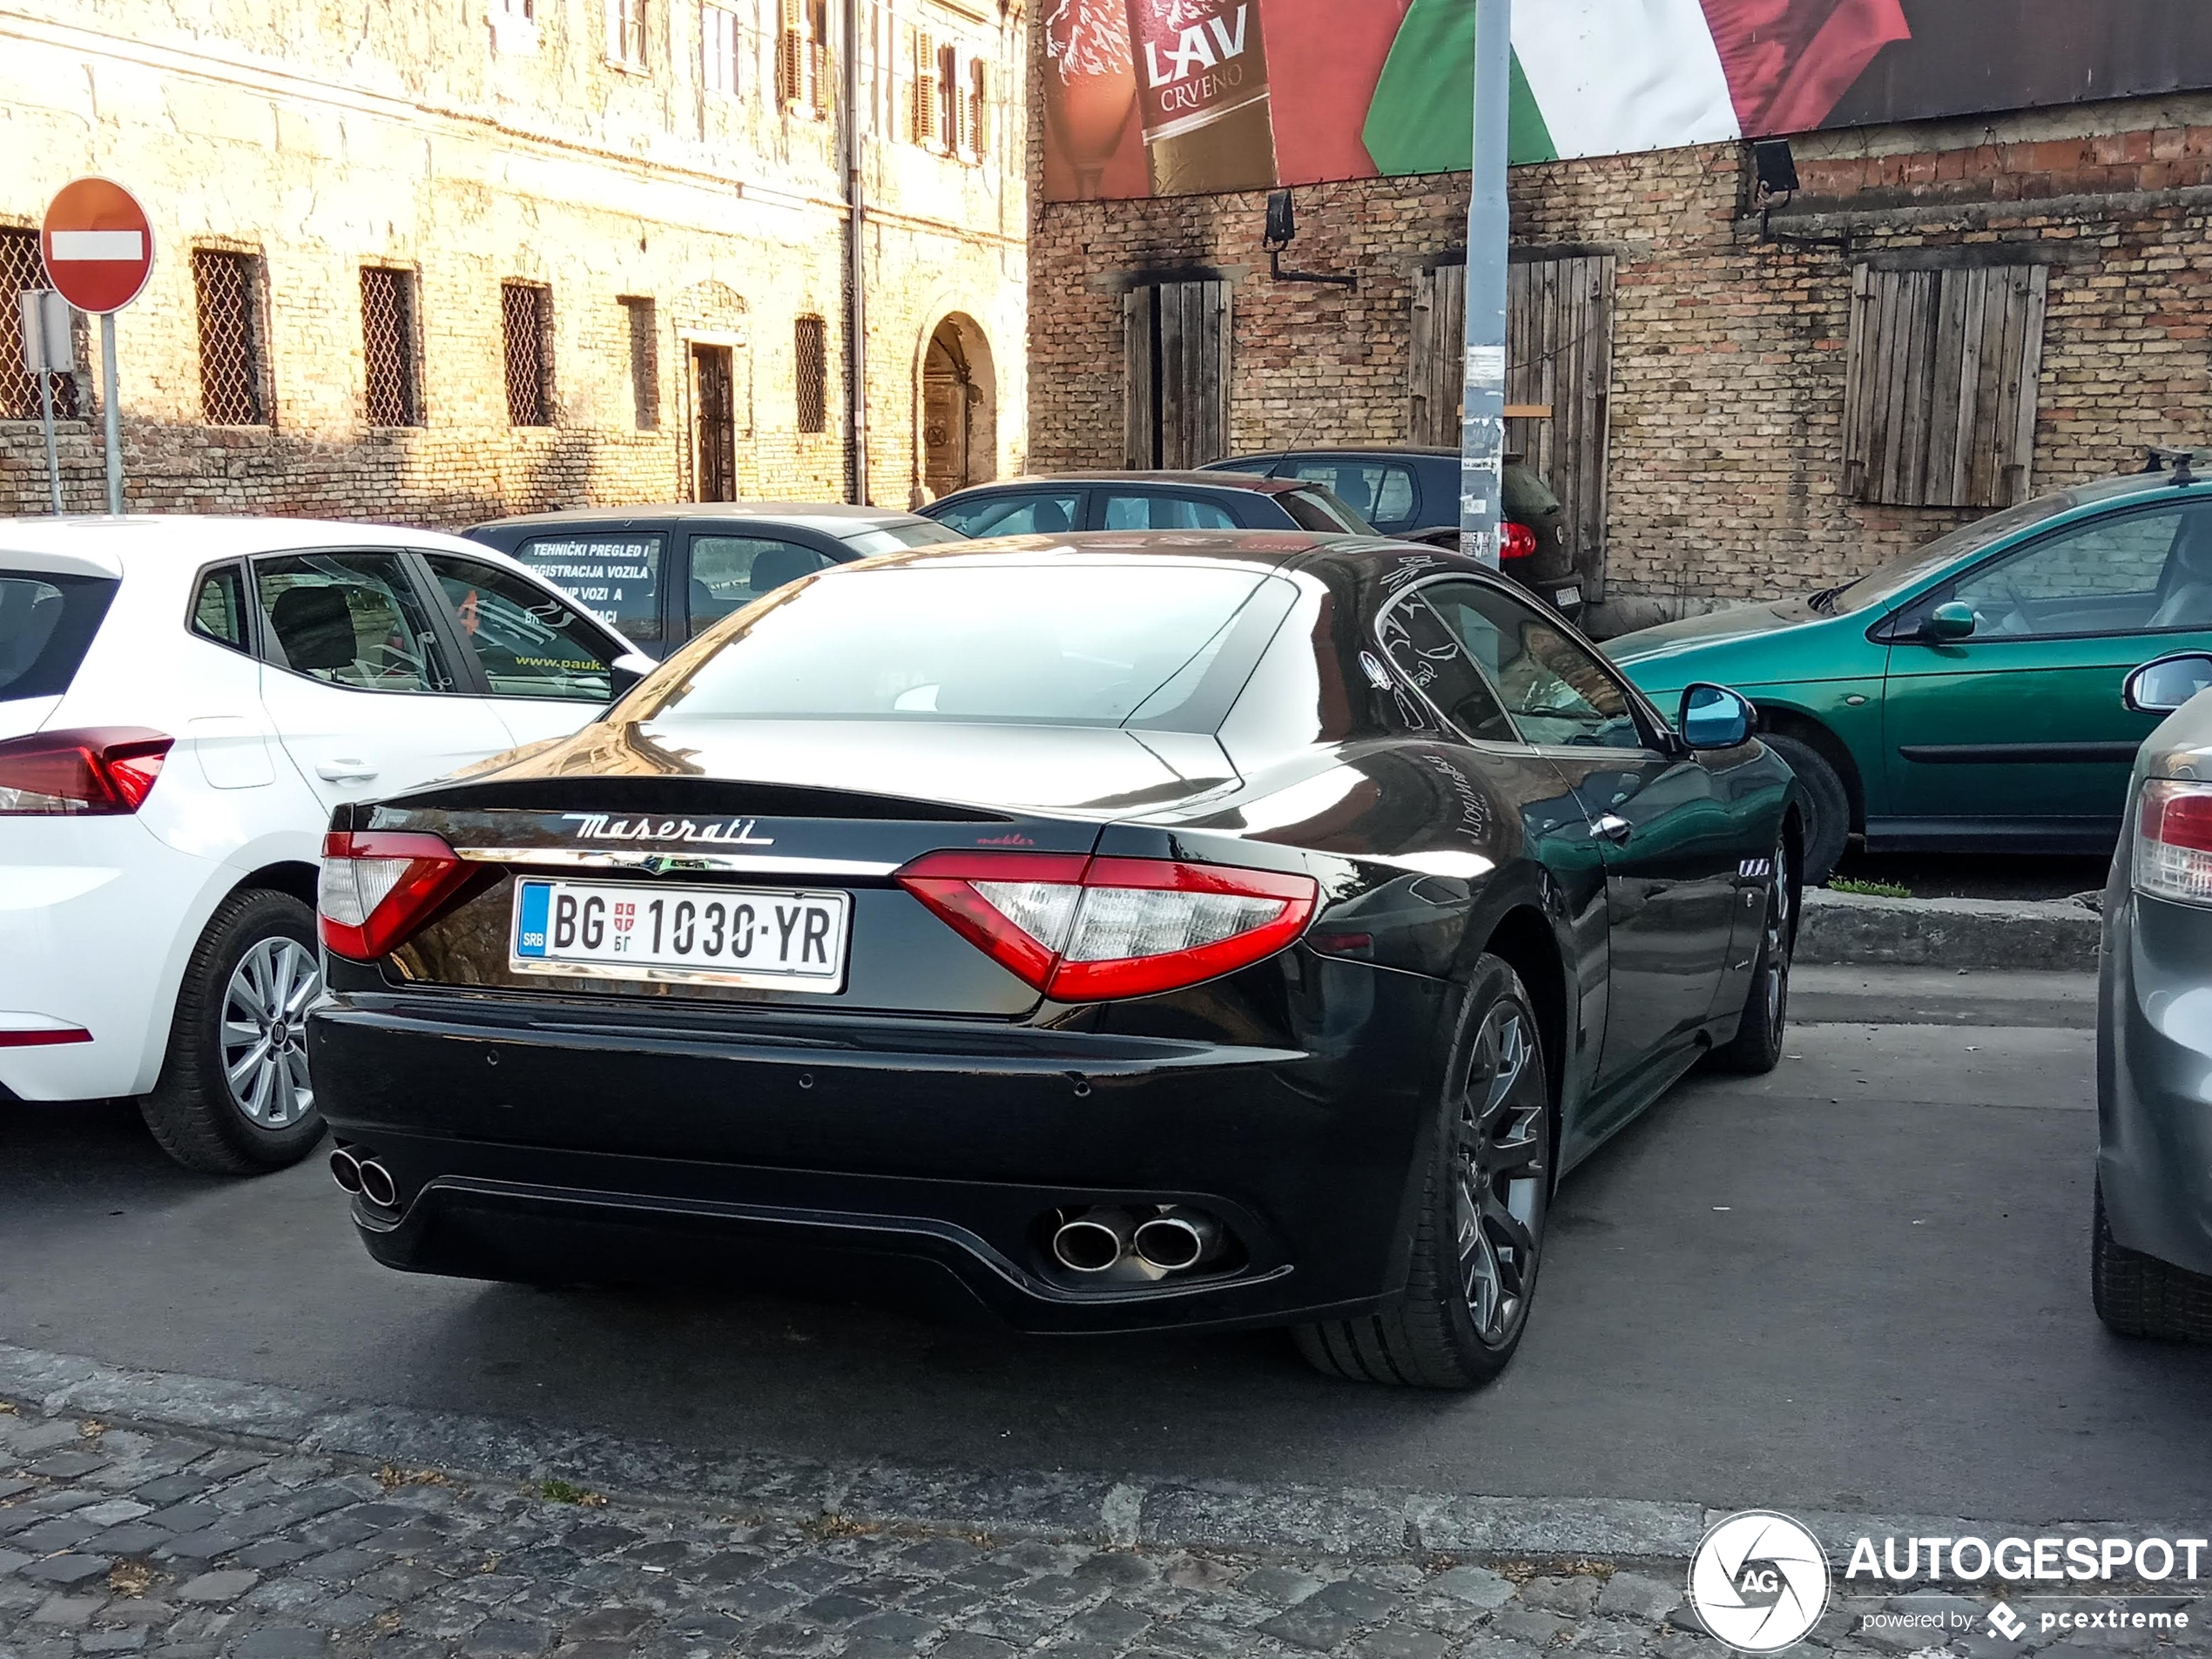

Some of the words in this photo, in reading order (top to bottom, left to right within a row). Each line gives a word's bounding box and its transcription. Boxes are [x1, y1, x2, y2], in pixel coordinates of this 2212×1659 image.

[1143, 3, 1247, 89] LAV
[1161, 64, 1243, 111] CRVENO
[534, 541, 587, 556] TEHNIČKI
[589, 544, 642, 557] PREGLED
[644, 545, 650, 557] I
[607, 565, 648, 579] VOZILA
[562, 813, 775, 845] Maserati
[554, 894, 605, 949] BG
[523, 933, 544, 947] SRB
